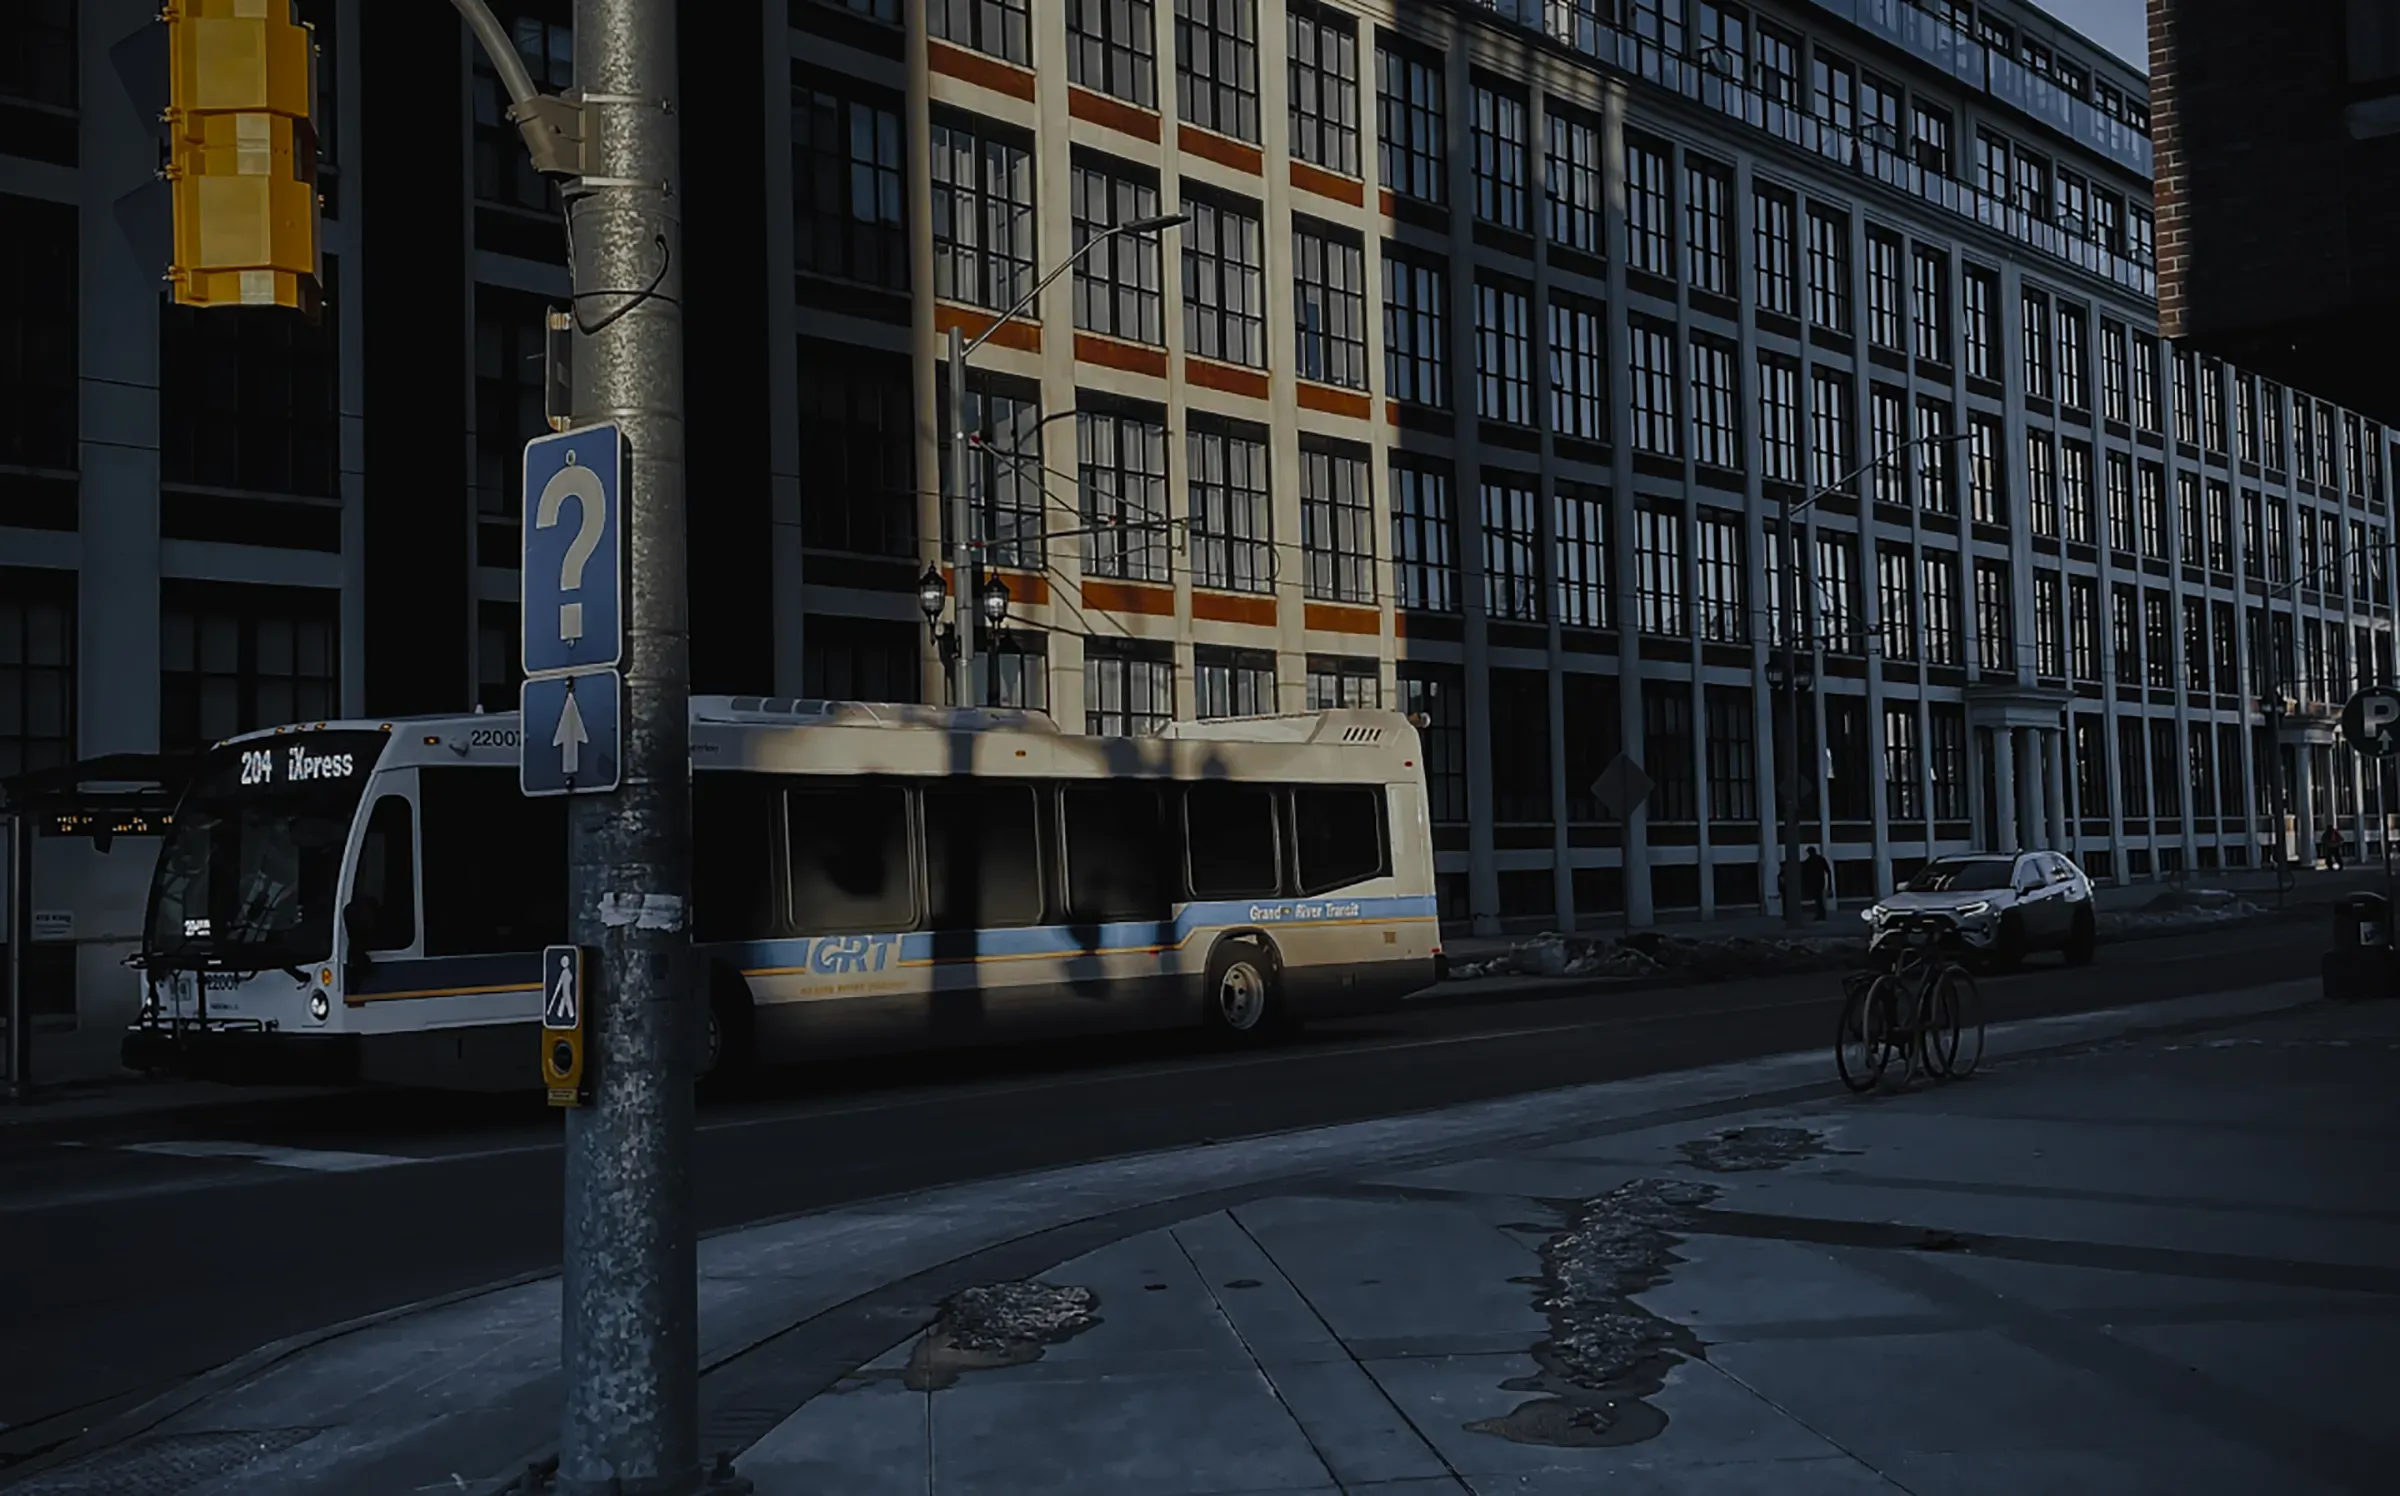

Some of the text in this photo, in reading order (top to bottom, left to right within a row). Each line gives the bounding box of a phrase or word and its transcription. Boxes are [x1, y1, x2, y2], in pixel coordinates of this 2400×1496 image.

[2363, 696, 2399, 738] P
[240, 744, 355, 785] 204 iXpress
[1249, 902, 1359, 921] Grand River Transit
[811, 933, 897, 974] GRT
